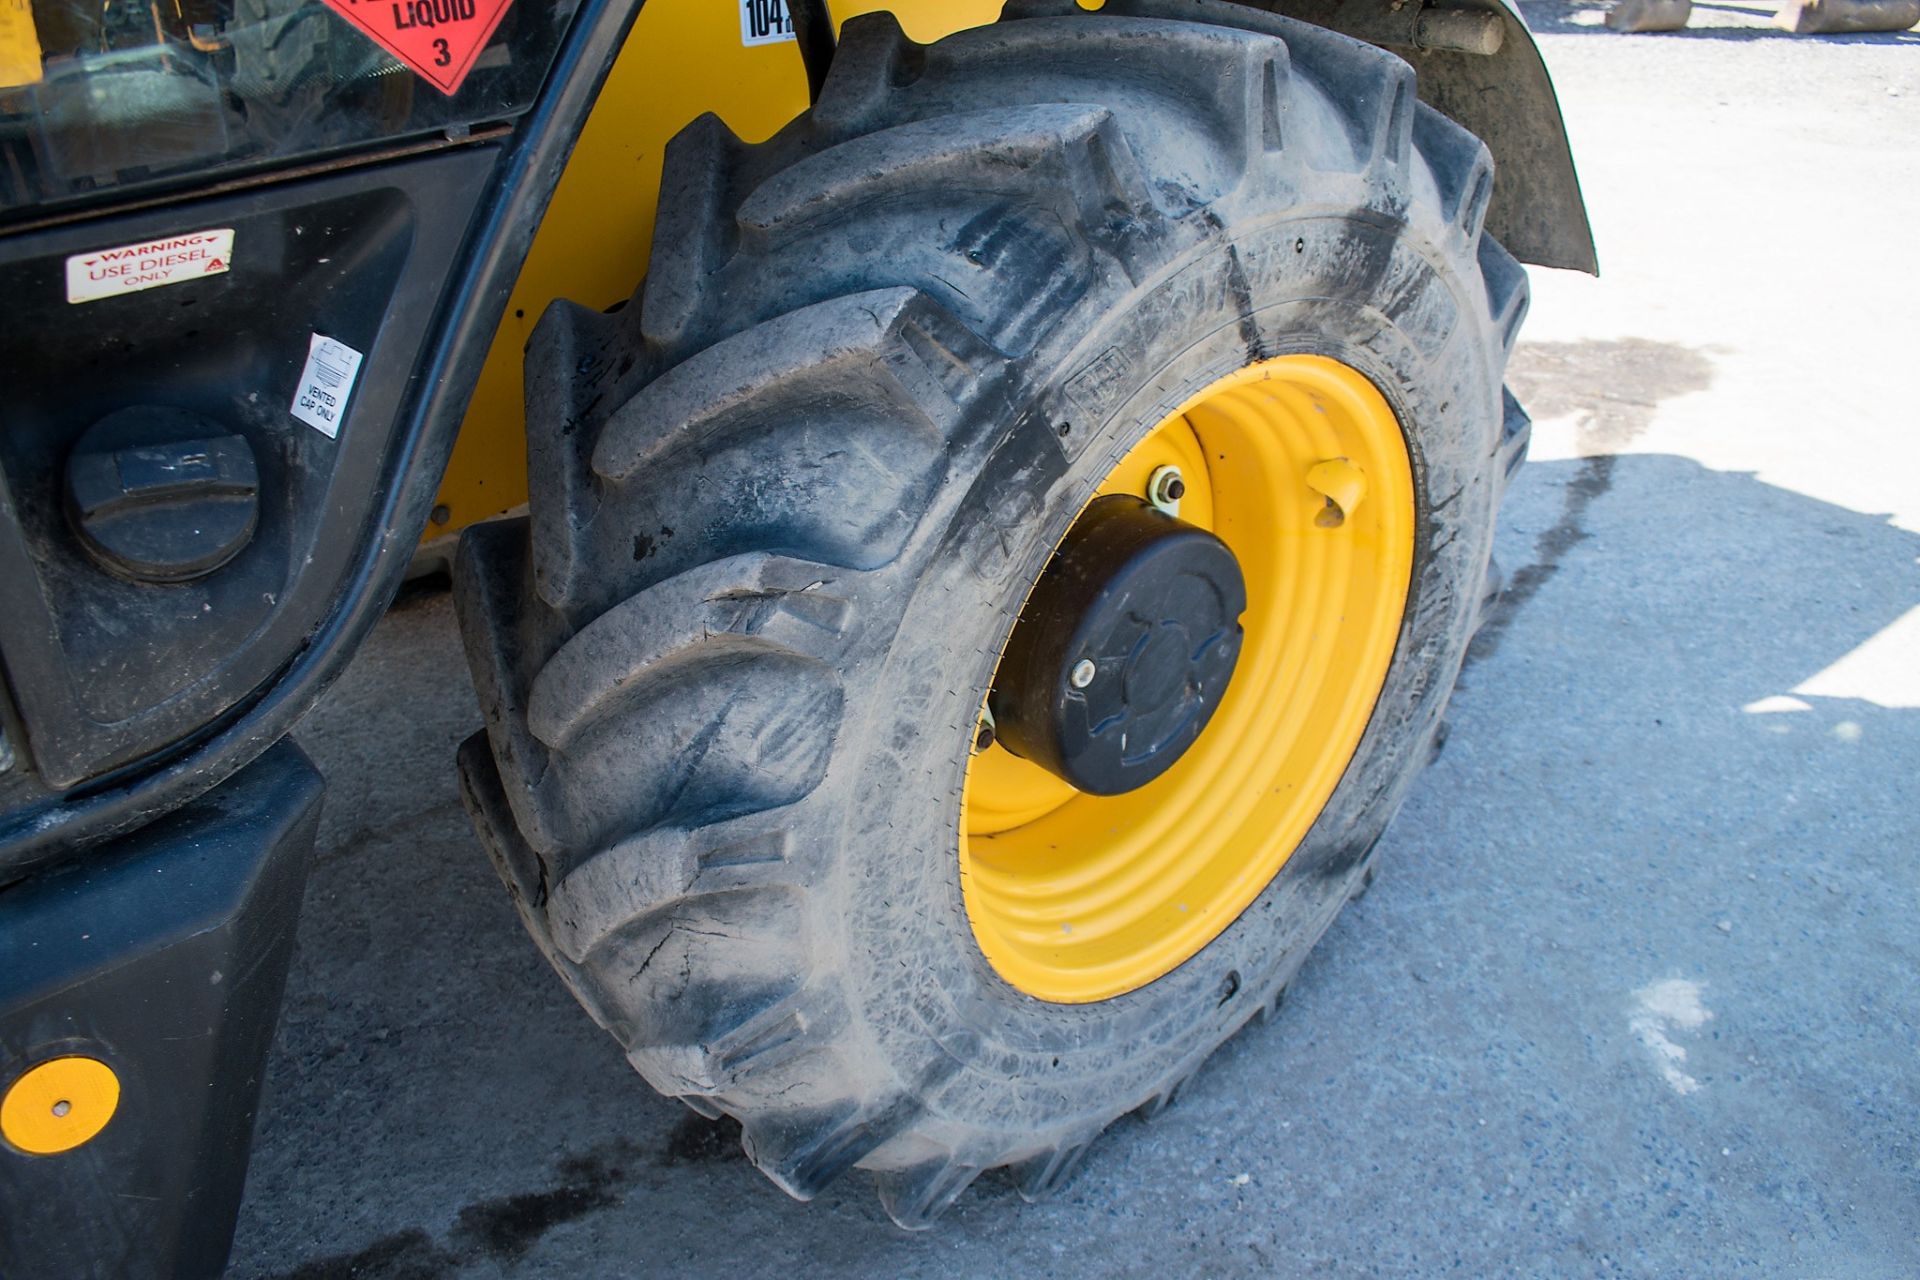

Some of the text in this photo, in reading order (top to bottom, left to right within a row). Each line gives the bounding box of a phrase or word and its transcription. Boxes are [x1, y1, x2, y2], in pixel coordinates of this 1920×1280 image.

[393, 0, 476, 30] LIQUID
[432, 38, 451, 67] 3
[101, 235, 202, 262] WARNING
[89, 248, 212, 281] USE DIESEL
[123, 268, 173, 286] ONLY
[300, 395, 337, 422] CAP ONLY
[308, 384, 337, 408] VENTED
